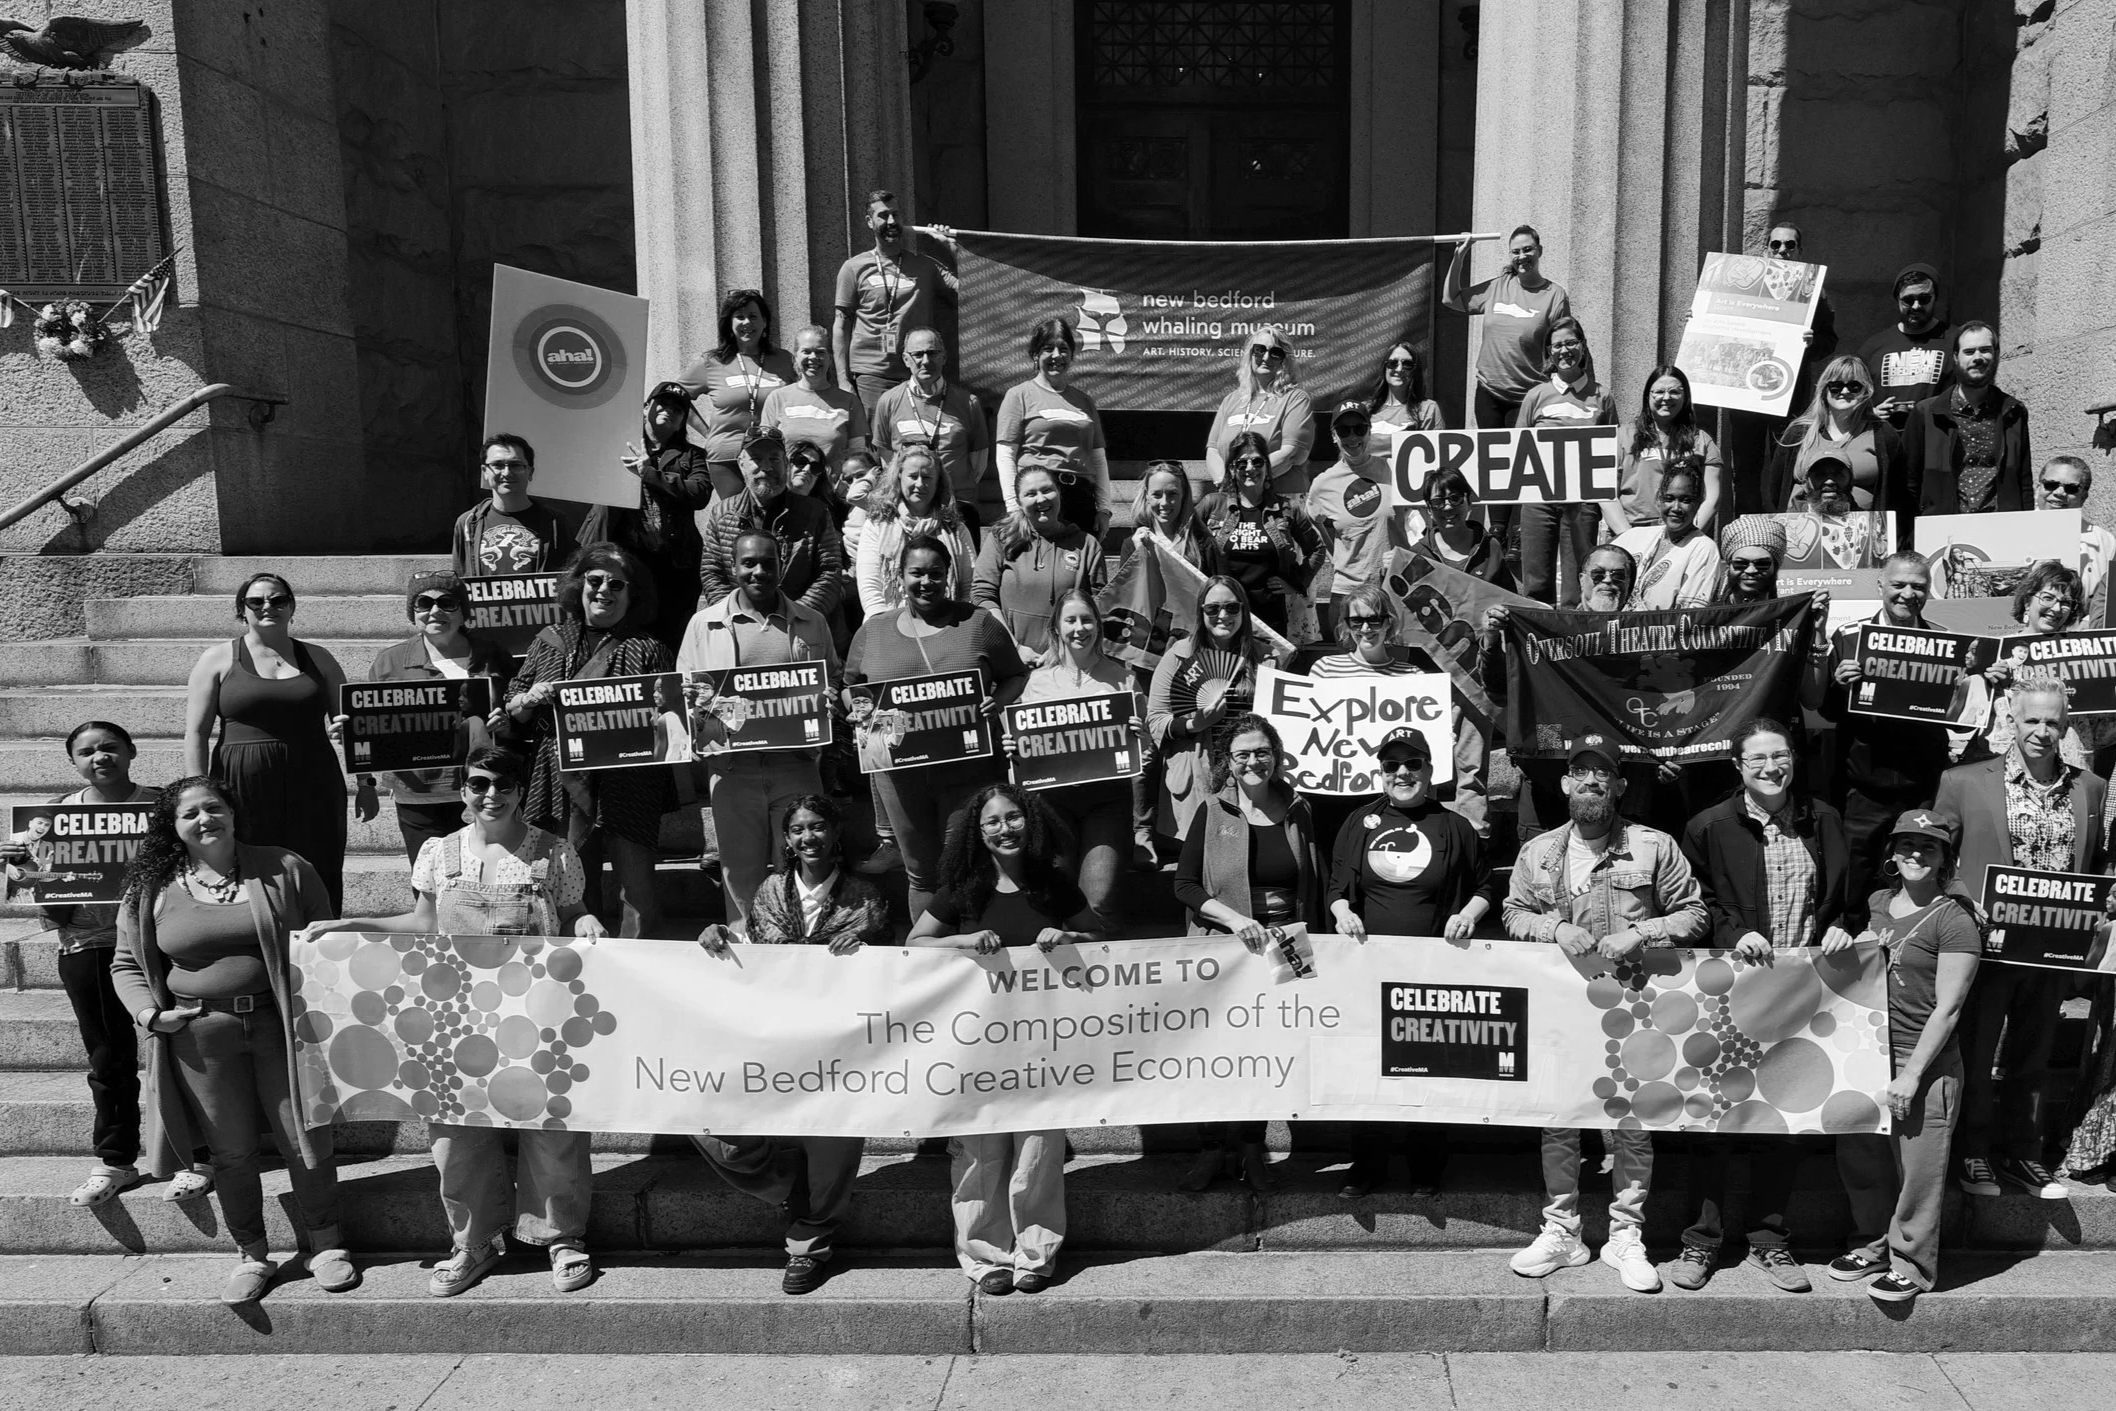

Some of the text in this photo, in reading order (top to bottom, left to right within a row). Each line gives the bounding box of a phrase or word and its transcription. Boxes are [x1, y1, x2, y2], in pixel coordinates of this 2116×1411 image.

[1142, 290, 1275, 309] new bedford
[1737, 301, 1780, 312] Everywhere
[1142, 316, 1315, 340] whaling muum
[547, 348, 594, 363] aha!
[1143, 347, 1316, 359] ART. HISTORY. SCIEN URE.
[1339, 401, 1360, 412] ART
[1395, 426, 1617, 503] CREATE
[1346, 485, 1380, 509] aha!
[1231, 528, 1262, 537] RIGHT
[1239, 522, 1257, 530] THE
[1229, 535, 1268, 544] O BEAR
[1232, 542, 1260, 551] ARTS
[1776, 577, 1853, 588] rt is Everywhere
[1777, 587, 1795, 595] rant
[464, 603, 562, 629] CREATIVIT
[1868, 632, 1958, 659] CELEBRATE
[733, 667, 819, 693] CELEBRATE
[1183, 660, 1204, 687] ART
[1864, 656, 1967, 687] CREATIVITY
[2022, 658, 2116, 681] CREATIVIT
[351, 686, 447, 709] CELEBRATE
[559, 682, 644, 707] CELEBRATE
[890, 676, 975, 705] CELEBRATE
[1716, 682, 1741, 691] 1994
[564, 706, 659, 733] CREATIVITY
[721, 693, 819, 721] CREATIVITY
[882, 703, 977, 736] CREATIVITY
[1015, 699, 1113, 731] CELEBRATE
[1270, 677, 1445, 737] Explore
[1908, 704, 1946, 714] #CreativeMA
[352, 710, 463, 736] CREATIVITY
[1387, 728, 1414, 743] ART
[732, 740, 769, 748] #CreativeMA
[1017, 723, 1128, 759] CREATIVITY
[412, 754, 451, 762] #CreativeMA
[618, 750, 653, 759] #CreativeMA
[894, 754, 929, 764] #CreativeMA
[1021, 777, 1057, 787] #CreativeMA
[1282, 751, 1382, 793] Bedfor
[54, 811, 155, 837] CELEBRA
[38, 838, 146, 866] CREATIV
[44, 891, 94, 900] #CreativeMA
[1995, 873, 2097, 903] CELEBRATE
[1992, 901, 2109, 932] CREATIVITY
[1270, 926, 1313, 979] aha!
[2043, 952, 2085, 961] #CreativeMA
[985, 957, 1221, 995] WELCOME TO
[1390, 987, 1502, 1015] CELEBRATE
[856, 992, 1341, 1052] The Composition of the
[1390, 1016, 1518, 1047] CREATIVITY
[635, 1050, 1296, 1097] New Bedford Creative Economy
